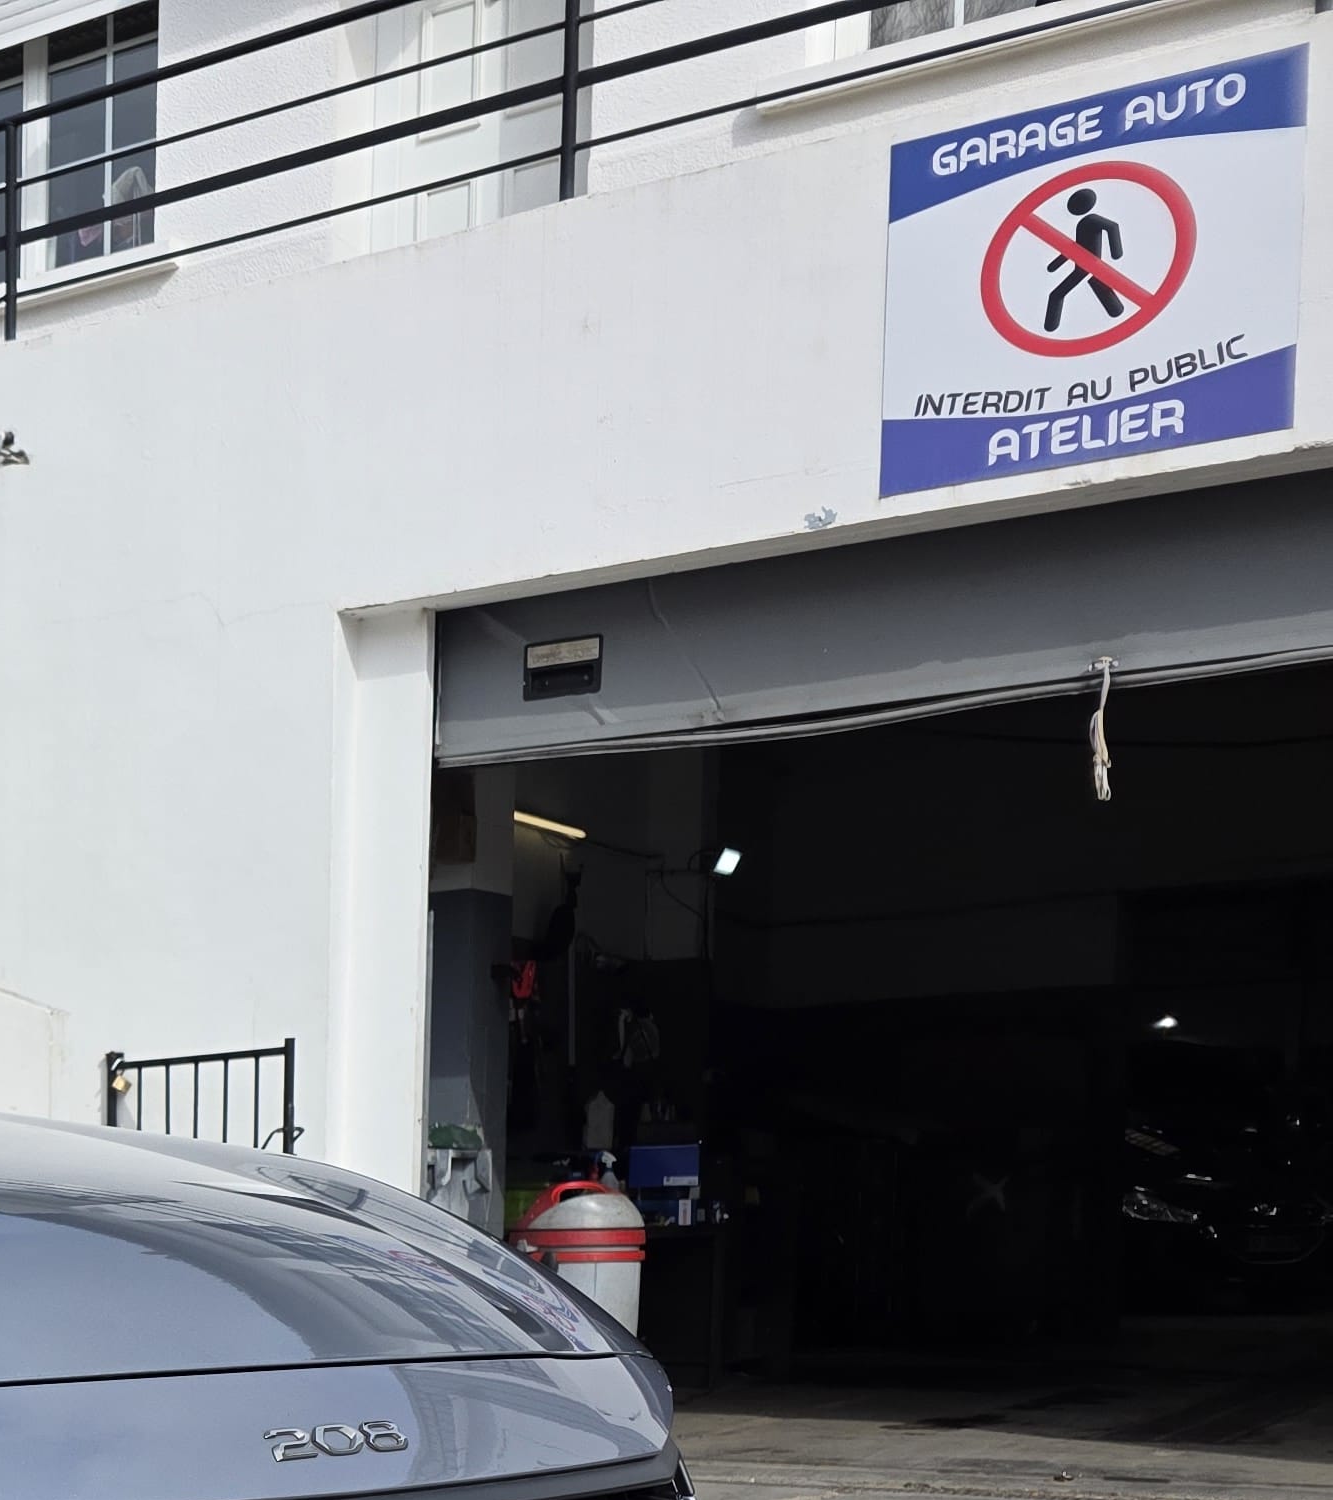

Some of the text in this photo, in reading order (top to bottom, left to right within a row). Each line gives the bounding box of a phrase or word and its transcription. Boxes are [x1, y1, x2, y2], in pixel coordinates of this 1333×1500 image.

[933, 72, 1247, 176] GARAGE AUTO
[914, 333, 1249, 417] INTERDIT AU PUBLIC
[988, 399, 1185, 467] ATELIER
[263, 1419, 409, 1462] 208
